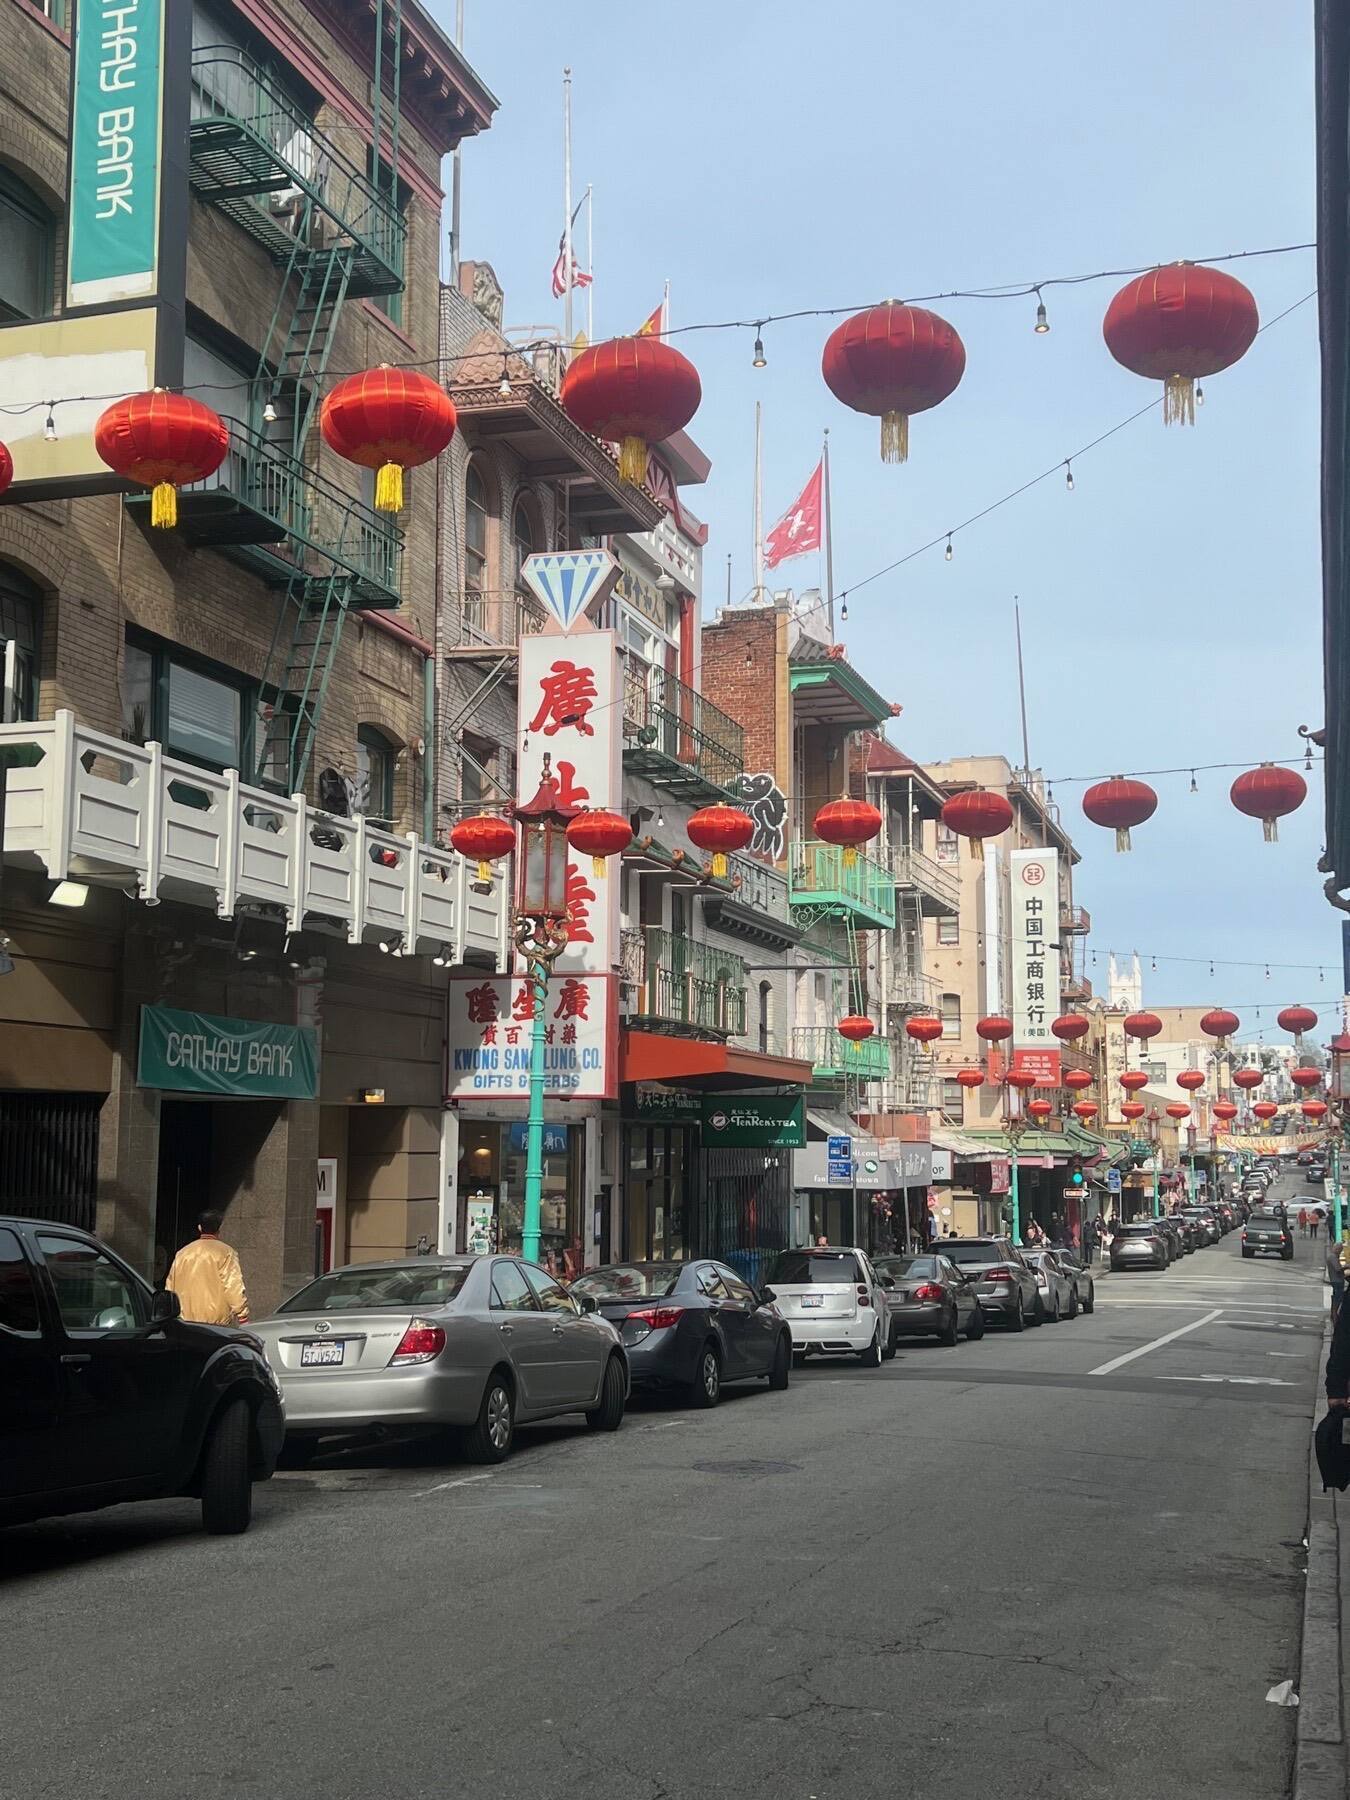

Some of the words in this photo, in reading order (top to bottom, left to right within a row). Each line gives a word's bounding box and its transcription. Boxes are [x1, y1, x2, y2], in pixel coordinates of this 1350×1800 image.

[99, 0, 138, 91] HAY
[95, 106, 135, 219] BANK
[1025, 897, 1045, 1024] 中国工商银行
[166, 1031, 242, 1073] CATHAY
[247, 1041, 294, 1078] BANK
[454, 1048, 499, 1070] KWONG
[504, 1048, 533, 1070] SAN
[544, 1048, 577, 1070] LUNG
[582, 1048, 602, 1070] CO.
[474, 1075, 513, 1088] GIFTS
[518, 1075, 528, 1088] &
[543, 1074, 580, 1088] ERBS
